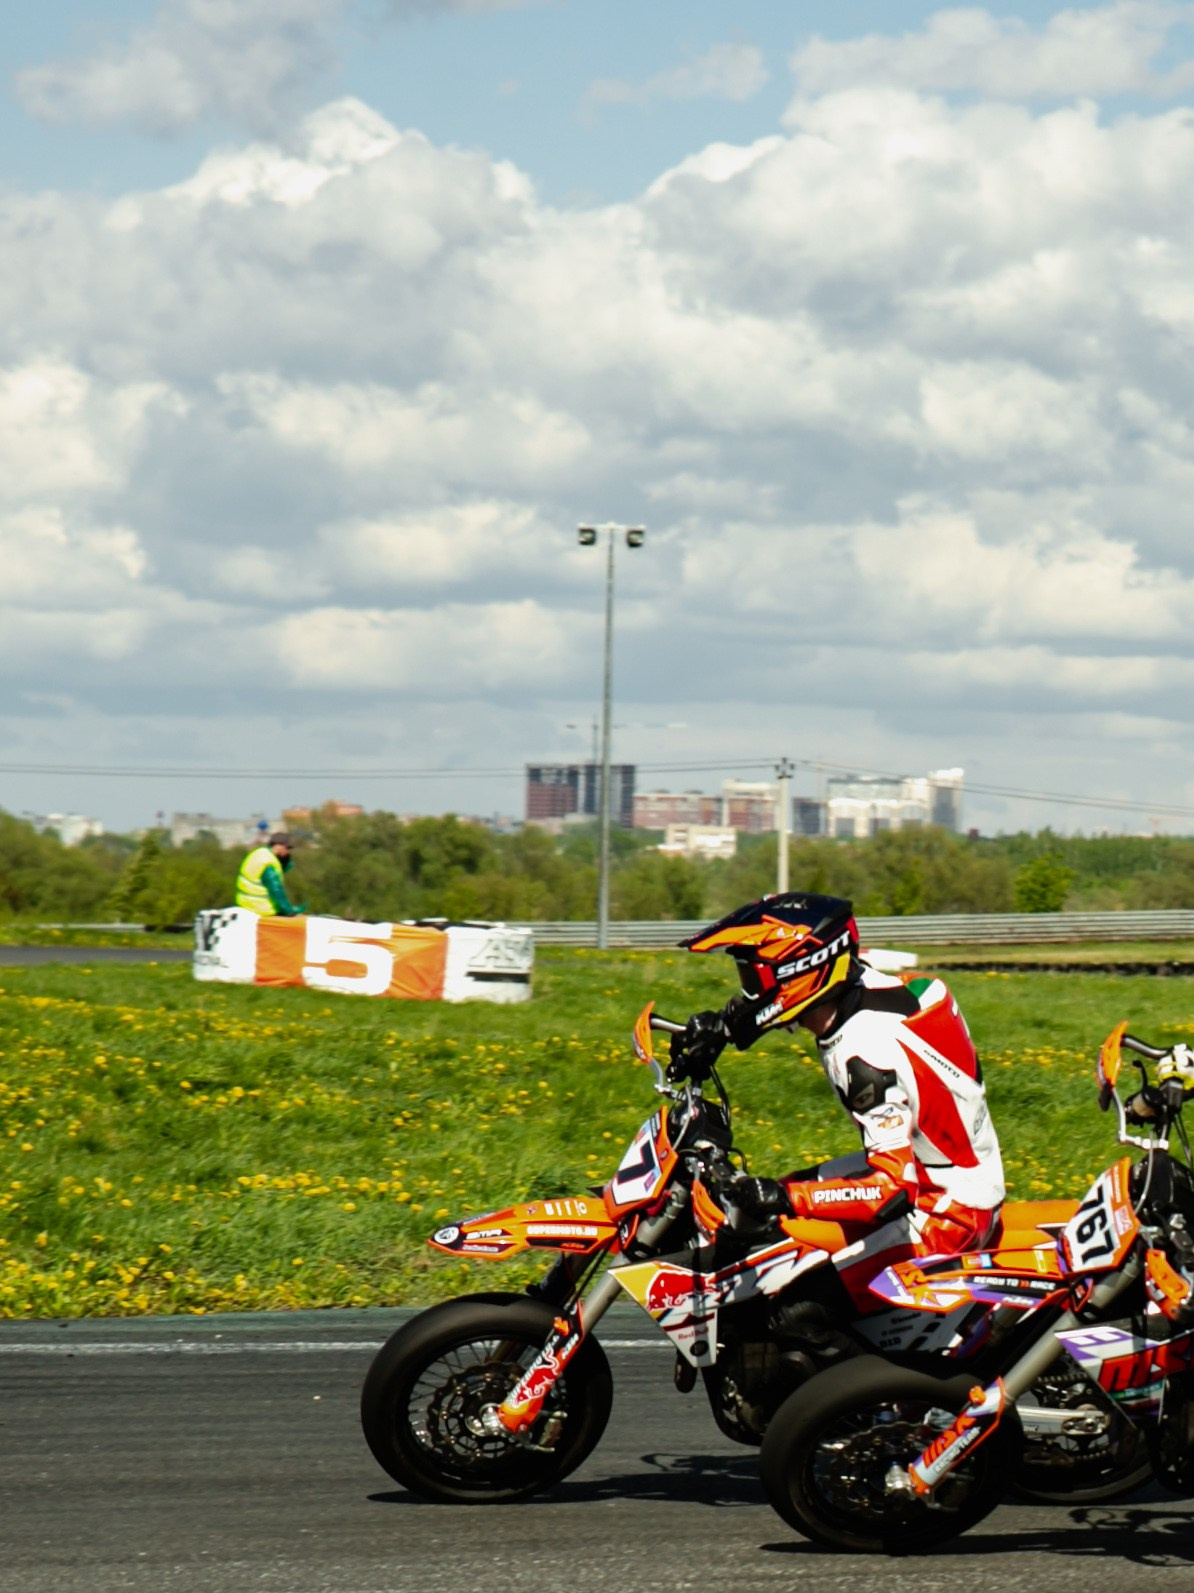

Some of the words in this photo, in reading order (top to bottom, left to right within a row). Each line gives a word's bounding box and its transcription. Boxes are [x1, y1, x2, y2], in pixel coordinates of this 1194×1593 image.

[302, 917, 396, 996] 5
[776, 930, 850, 979] SCOTT
[755, 1000, 784, 1026] KTM
[814, 1186, 882, 1204] PINCHUK
[1074, 1184, 1115, 1264] 767
[973, 1275, 1004, 1285] READY
[1006, 1278, 1019, 1287] TO
[1030, 1280, 1056, 1290] RACE
